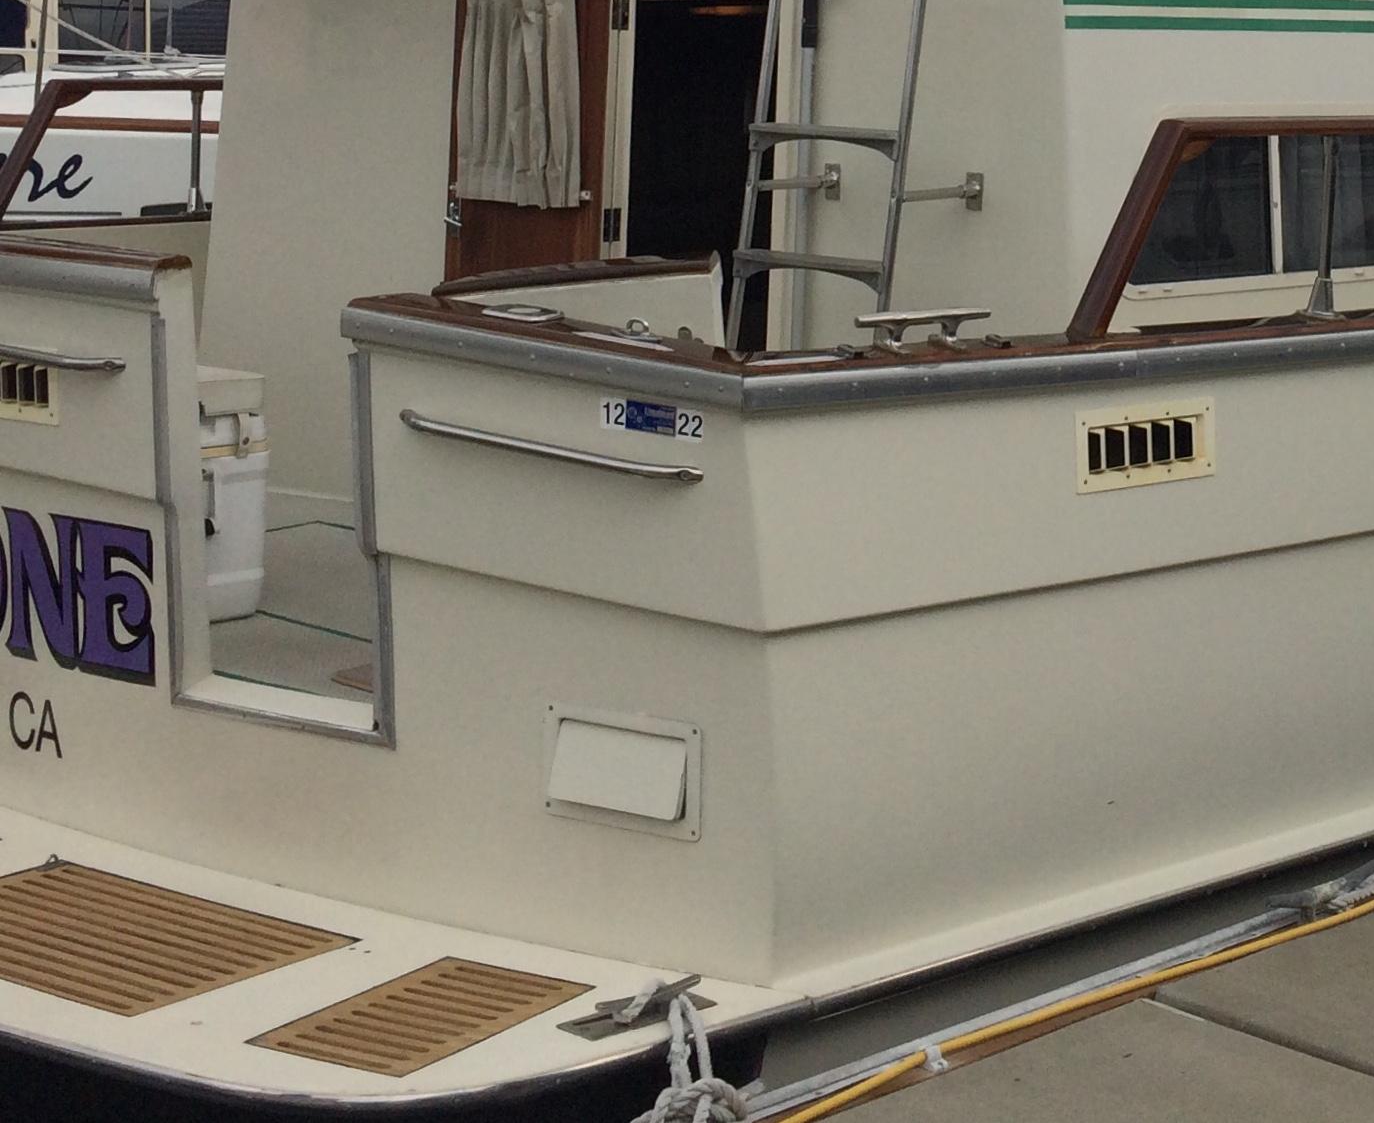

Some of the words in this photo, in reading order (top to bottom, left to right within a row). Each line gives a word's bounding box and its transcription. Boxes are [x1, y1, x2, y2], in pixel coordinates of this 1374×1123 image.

[603, 401, 625, 426] 12
[677, 412, 703, 438] 22
[0, 507, 156, 687] NE
[9, 691, 63, 759] CA
